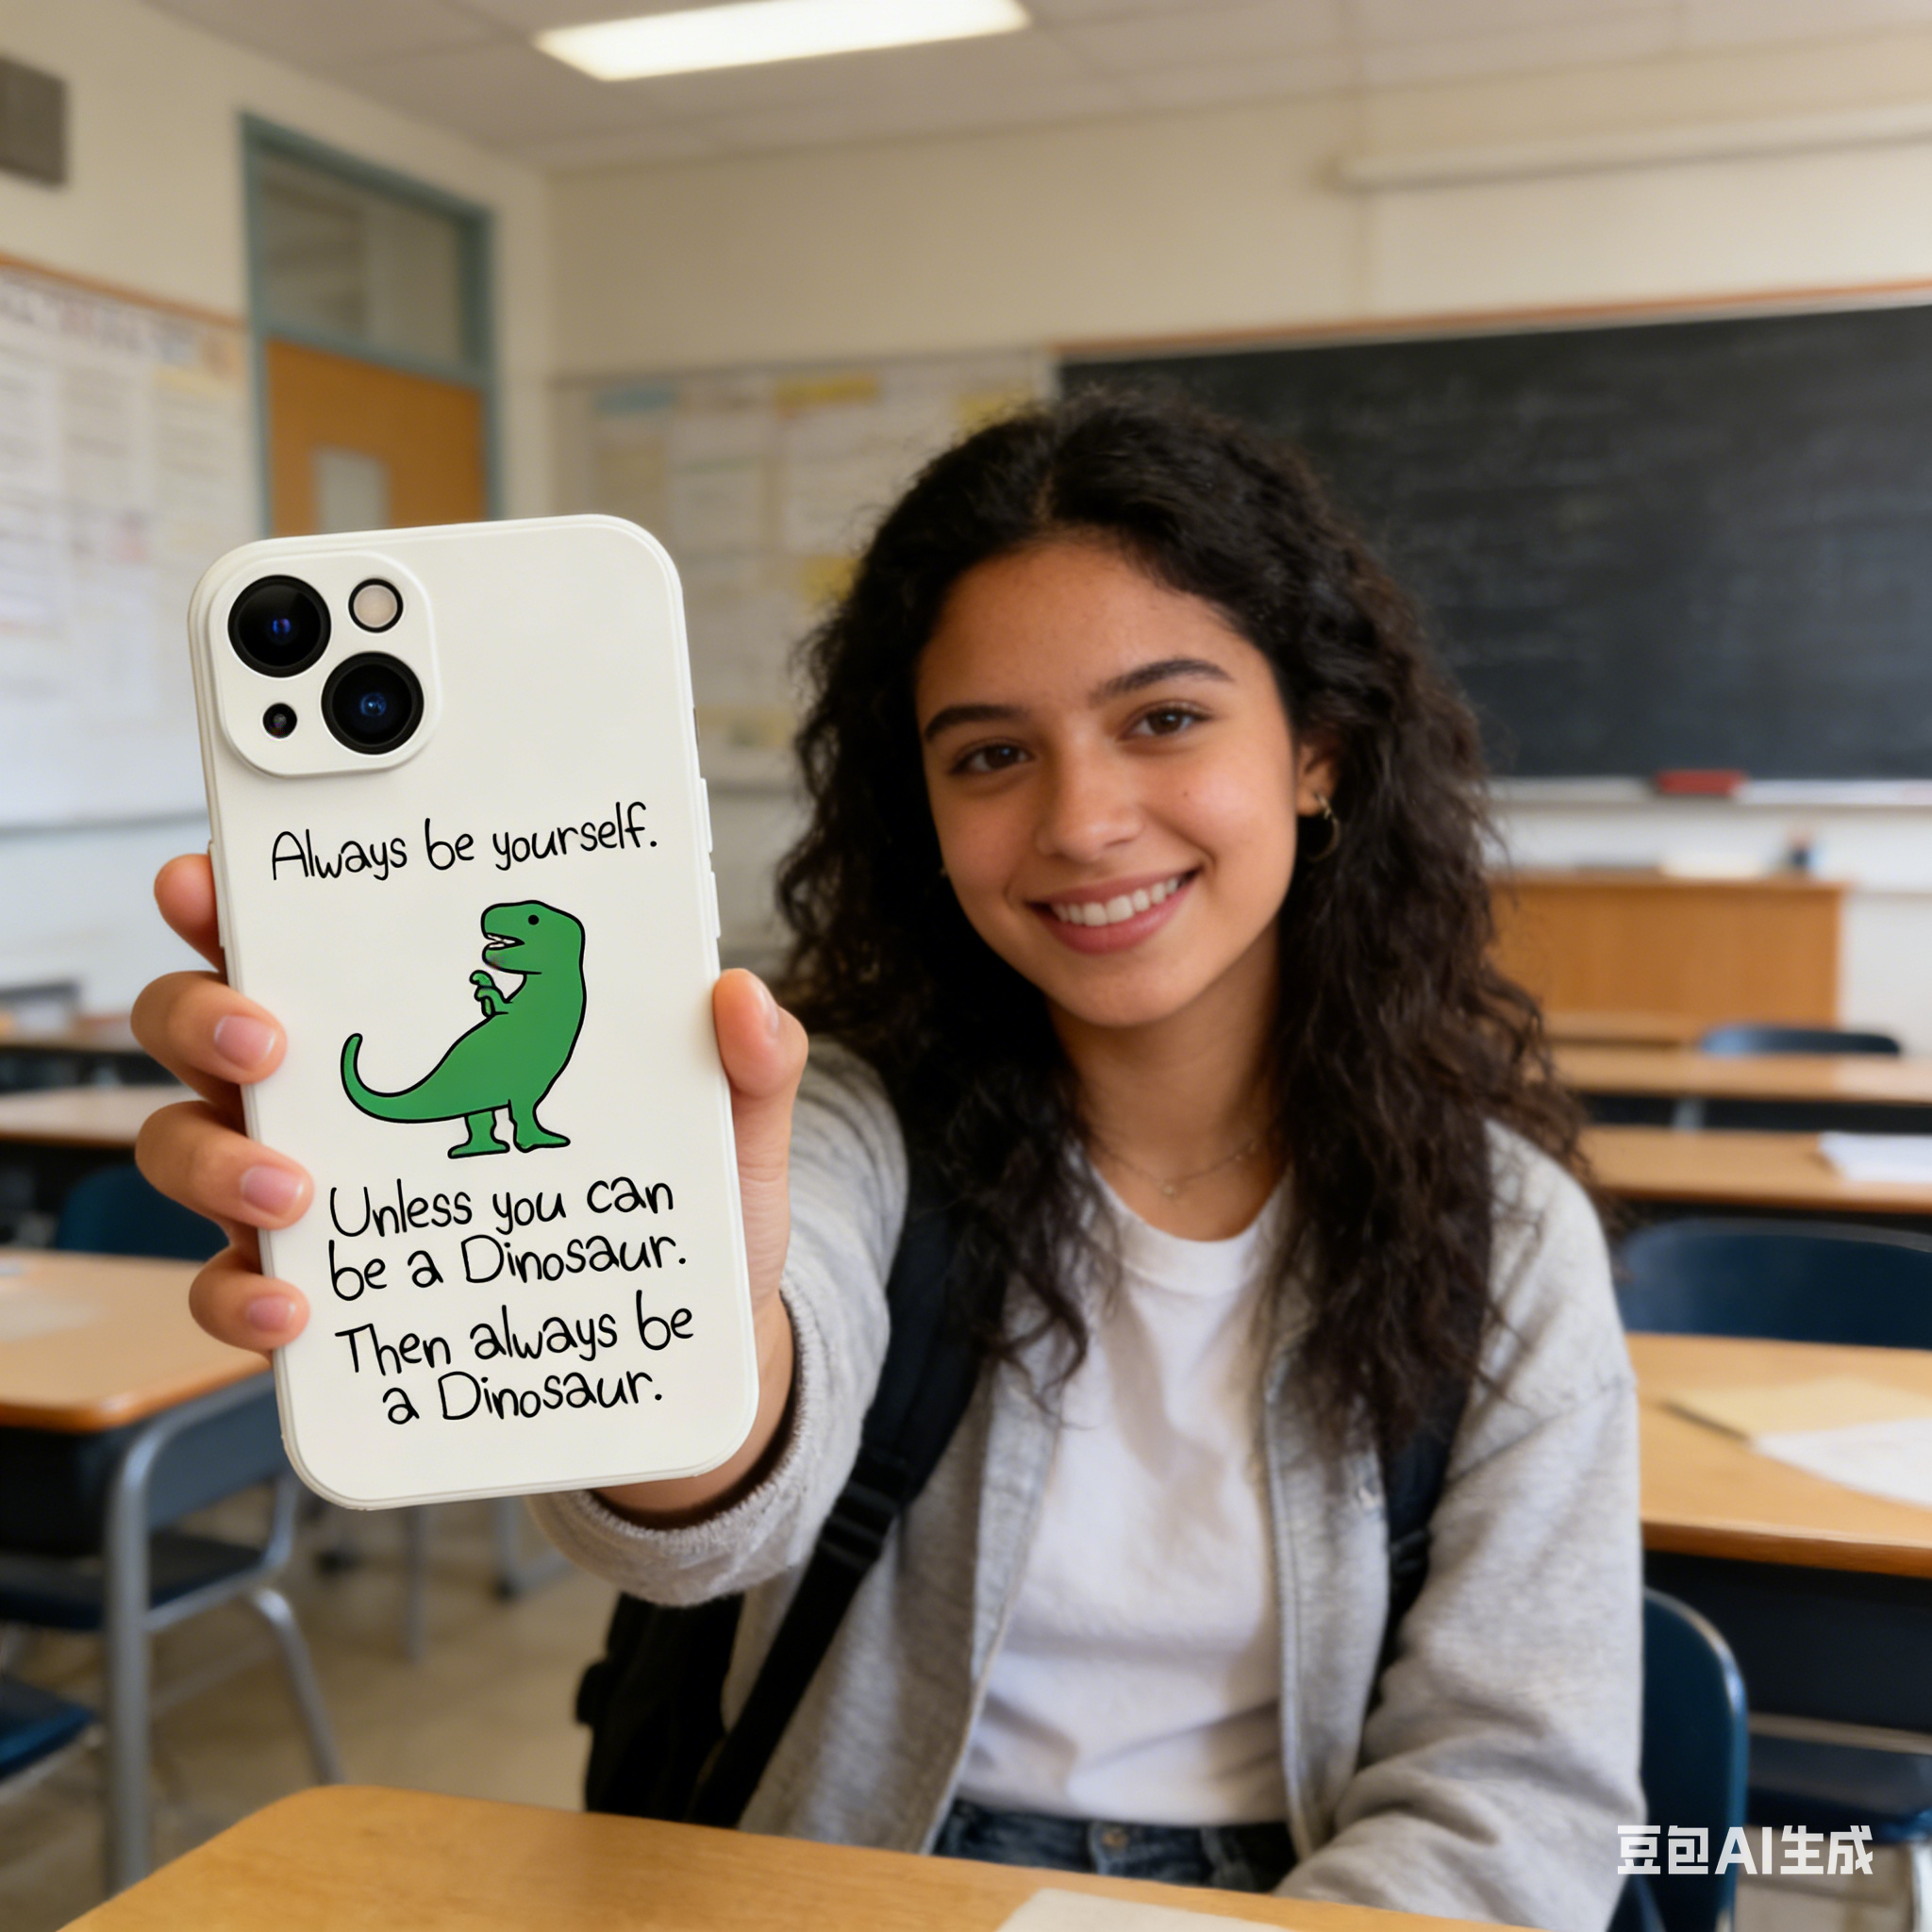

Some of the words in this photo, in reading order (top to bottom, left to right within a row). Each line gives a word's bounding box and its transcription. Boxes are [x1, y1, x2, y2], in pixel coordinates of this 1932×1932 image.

[272, 828, 408, 881] Always
[424, 817, 475, 871] be
[492, 801, 658, 872] yourself.
[329, 1177, 473, 1238] Unless
[491, 1191, 567, 1236] you
[586, 1176, 674, 1214] can
[328, 1239, 388, 1302] be
[407, 1250, 444, 1289] a
[460, 1234, 687, 1284] Dinosaur.
[334, 1323, 452, 1376] Then
[469, 1304, 618, 1362] always
[635, 1289, 694, 1351] be
[382, 1387, 420, 1425] a
[437, 1371, 662, 1421] Dinosaur.
